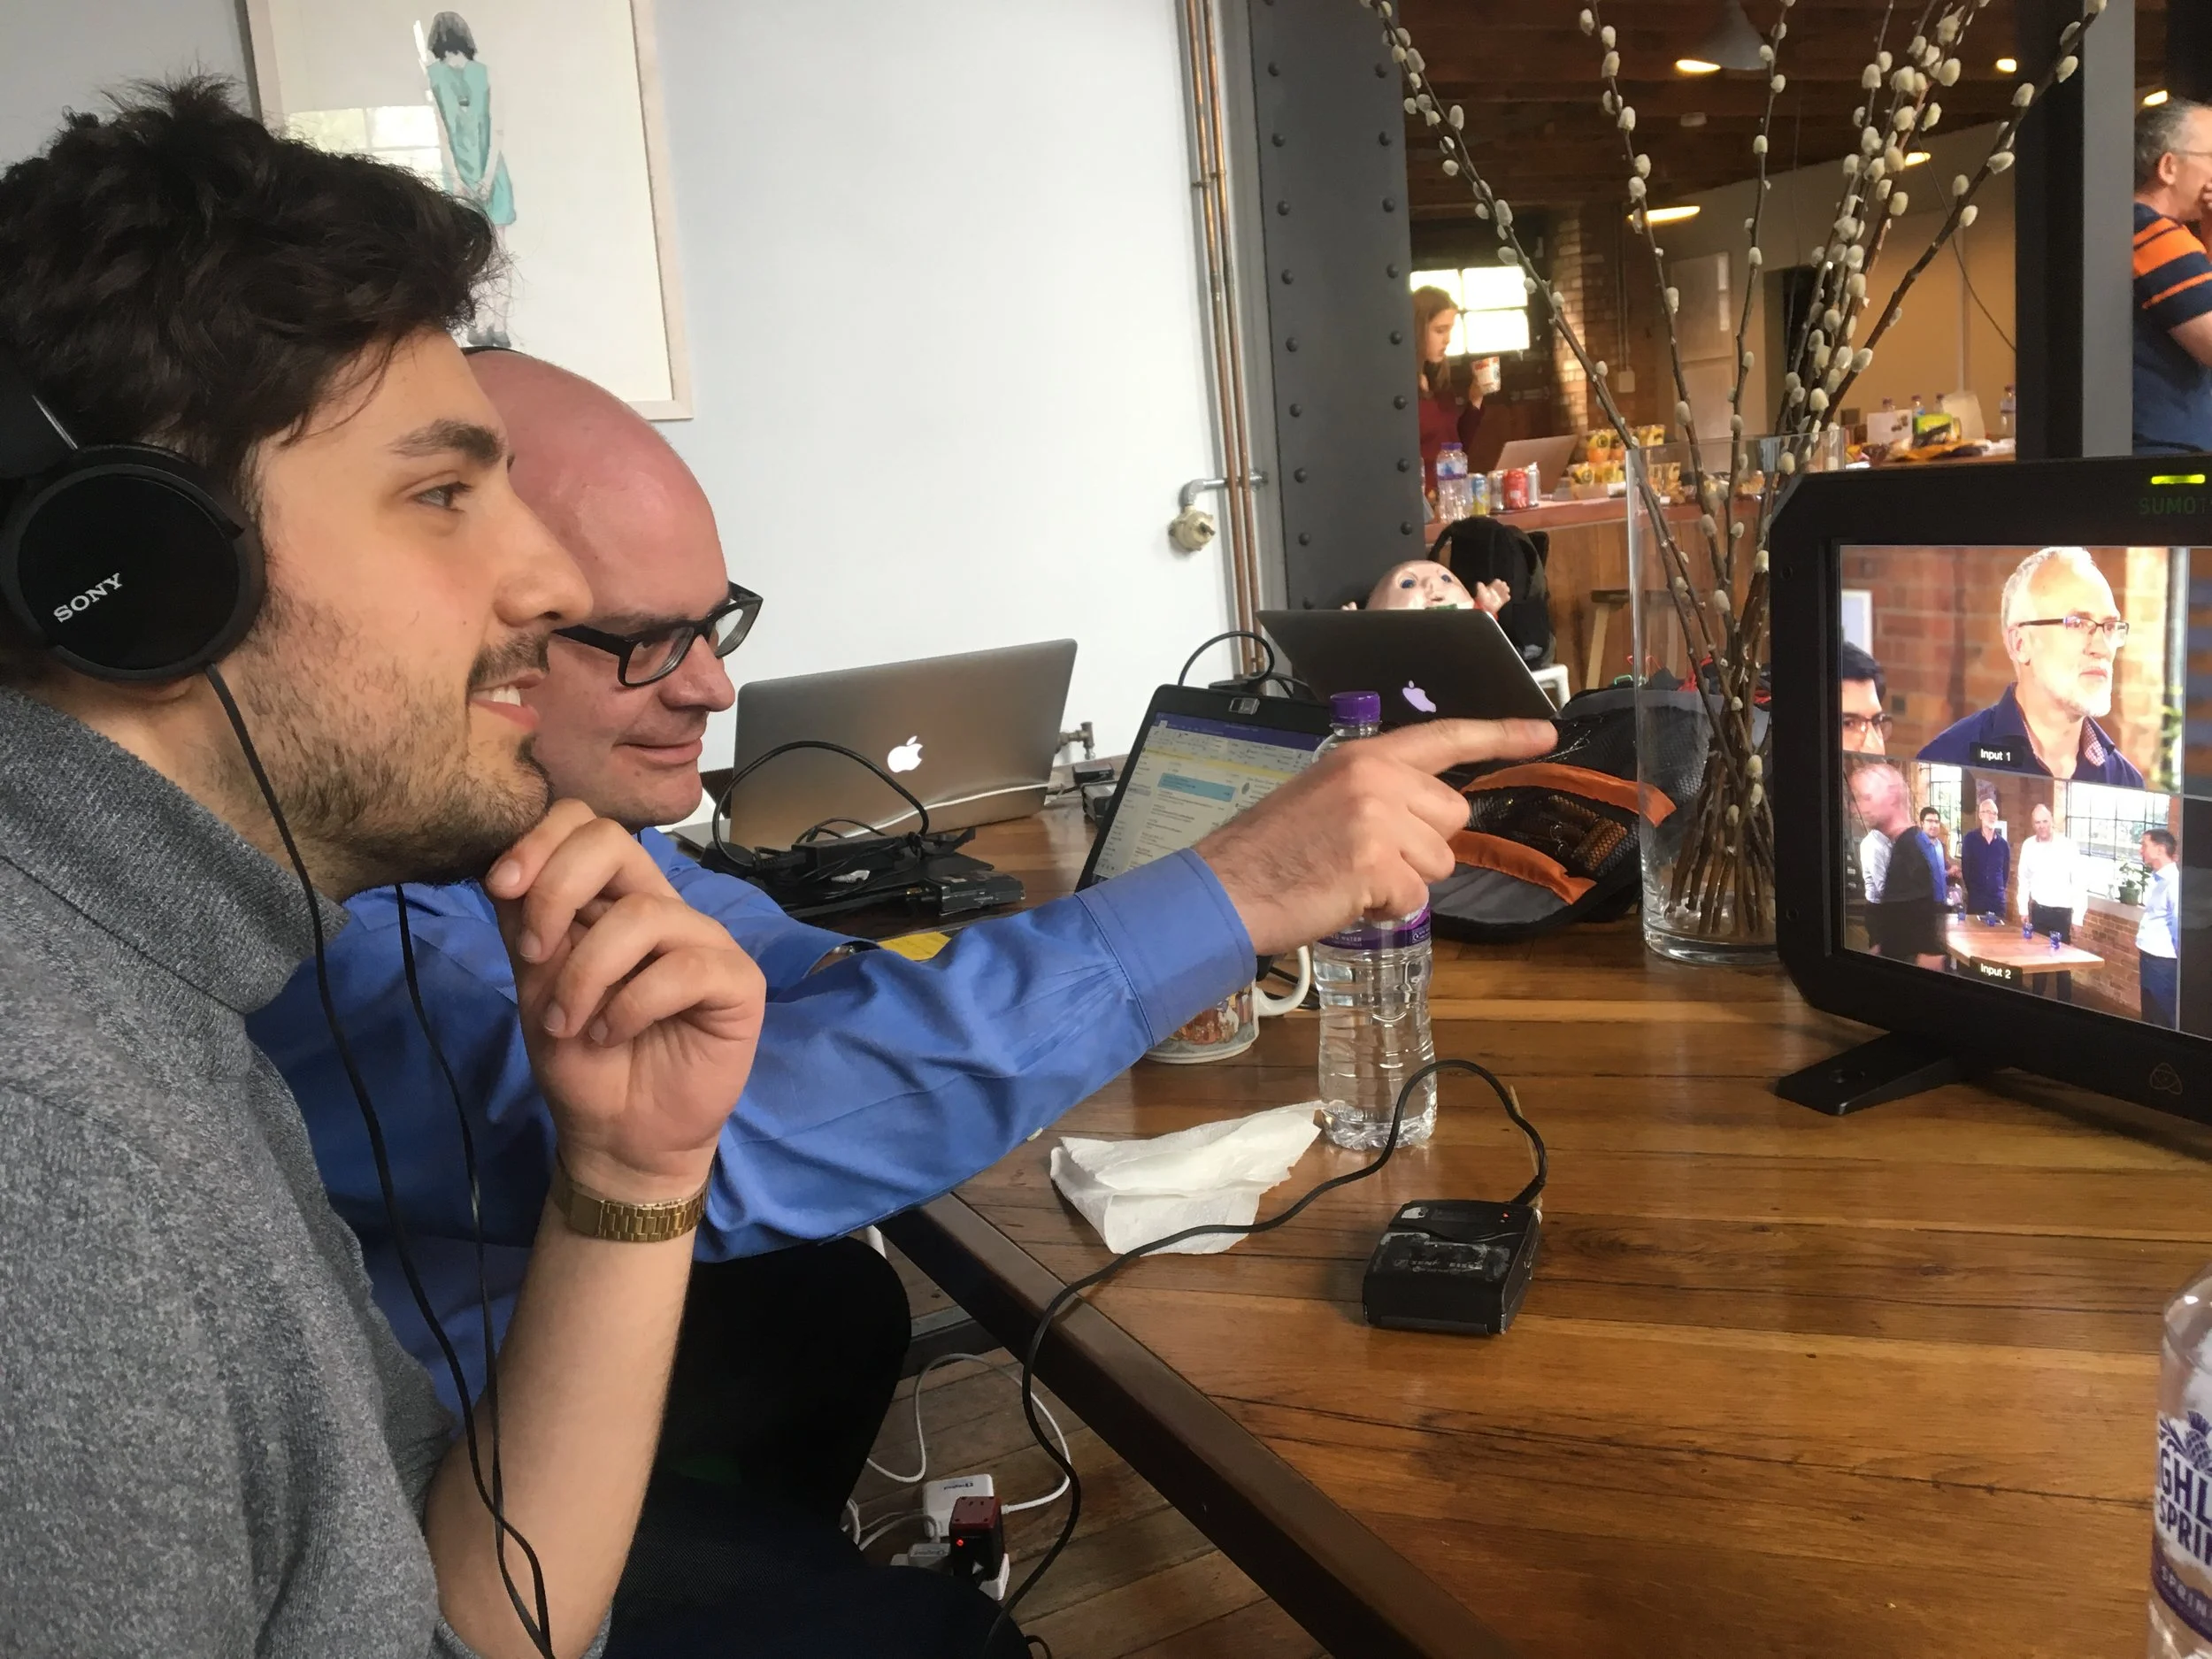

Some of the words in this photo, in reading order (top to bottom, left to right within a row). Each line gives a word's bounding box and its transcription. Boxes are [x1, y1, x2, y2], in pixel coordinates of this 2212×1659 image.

[53, 572, 124, 624] SONY
[1980, 749, 2003, 761] Input
[2006, 751, 2011, 762] 1
[1980, 963, 2003, 978] Input
[2005, 969, 2011, 979] 2
[2158, 1448, 2212, 1530] GHL
